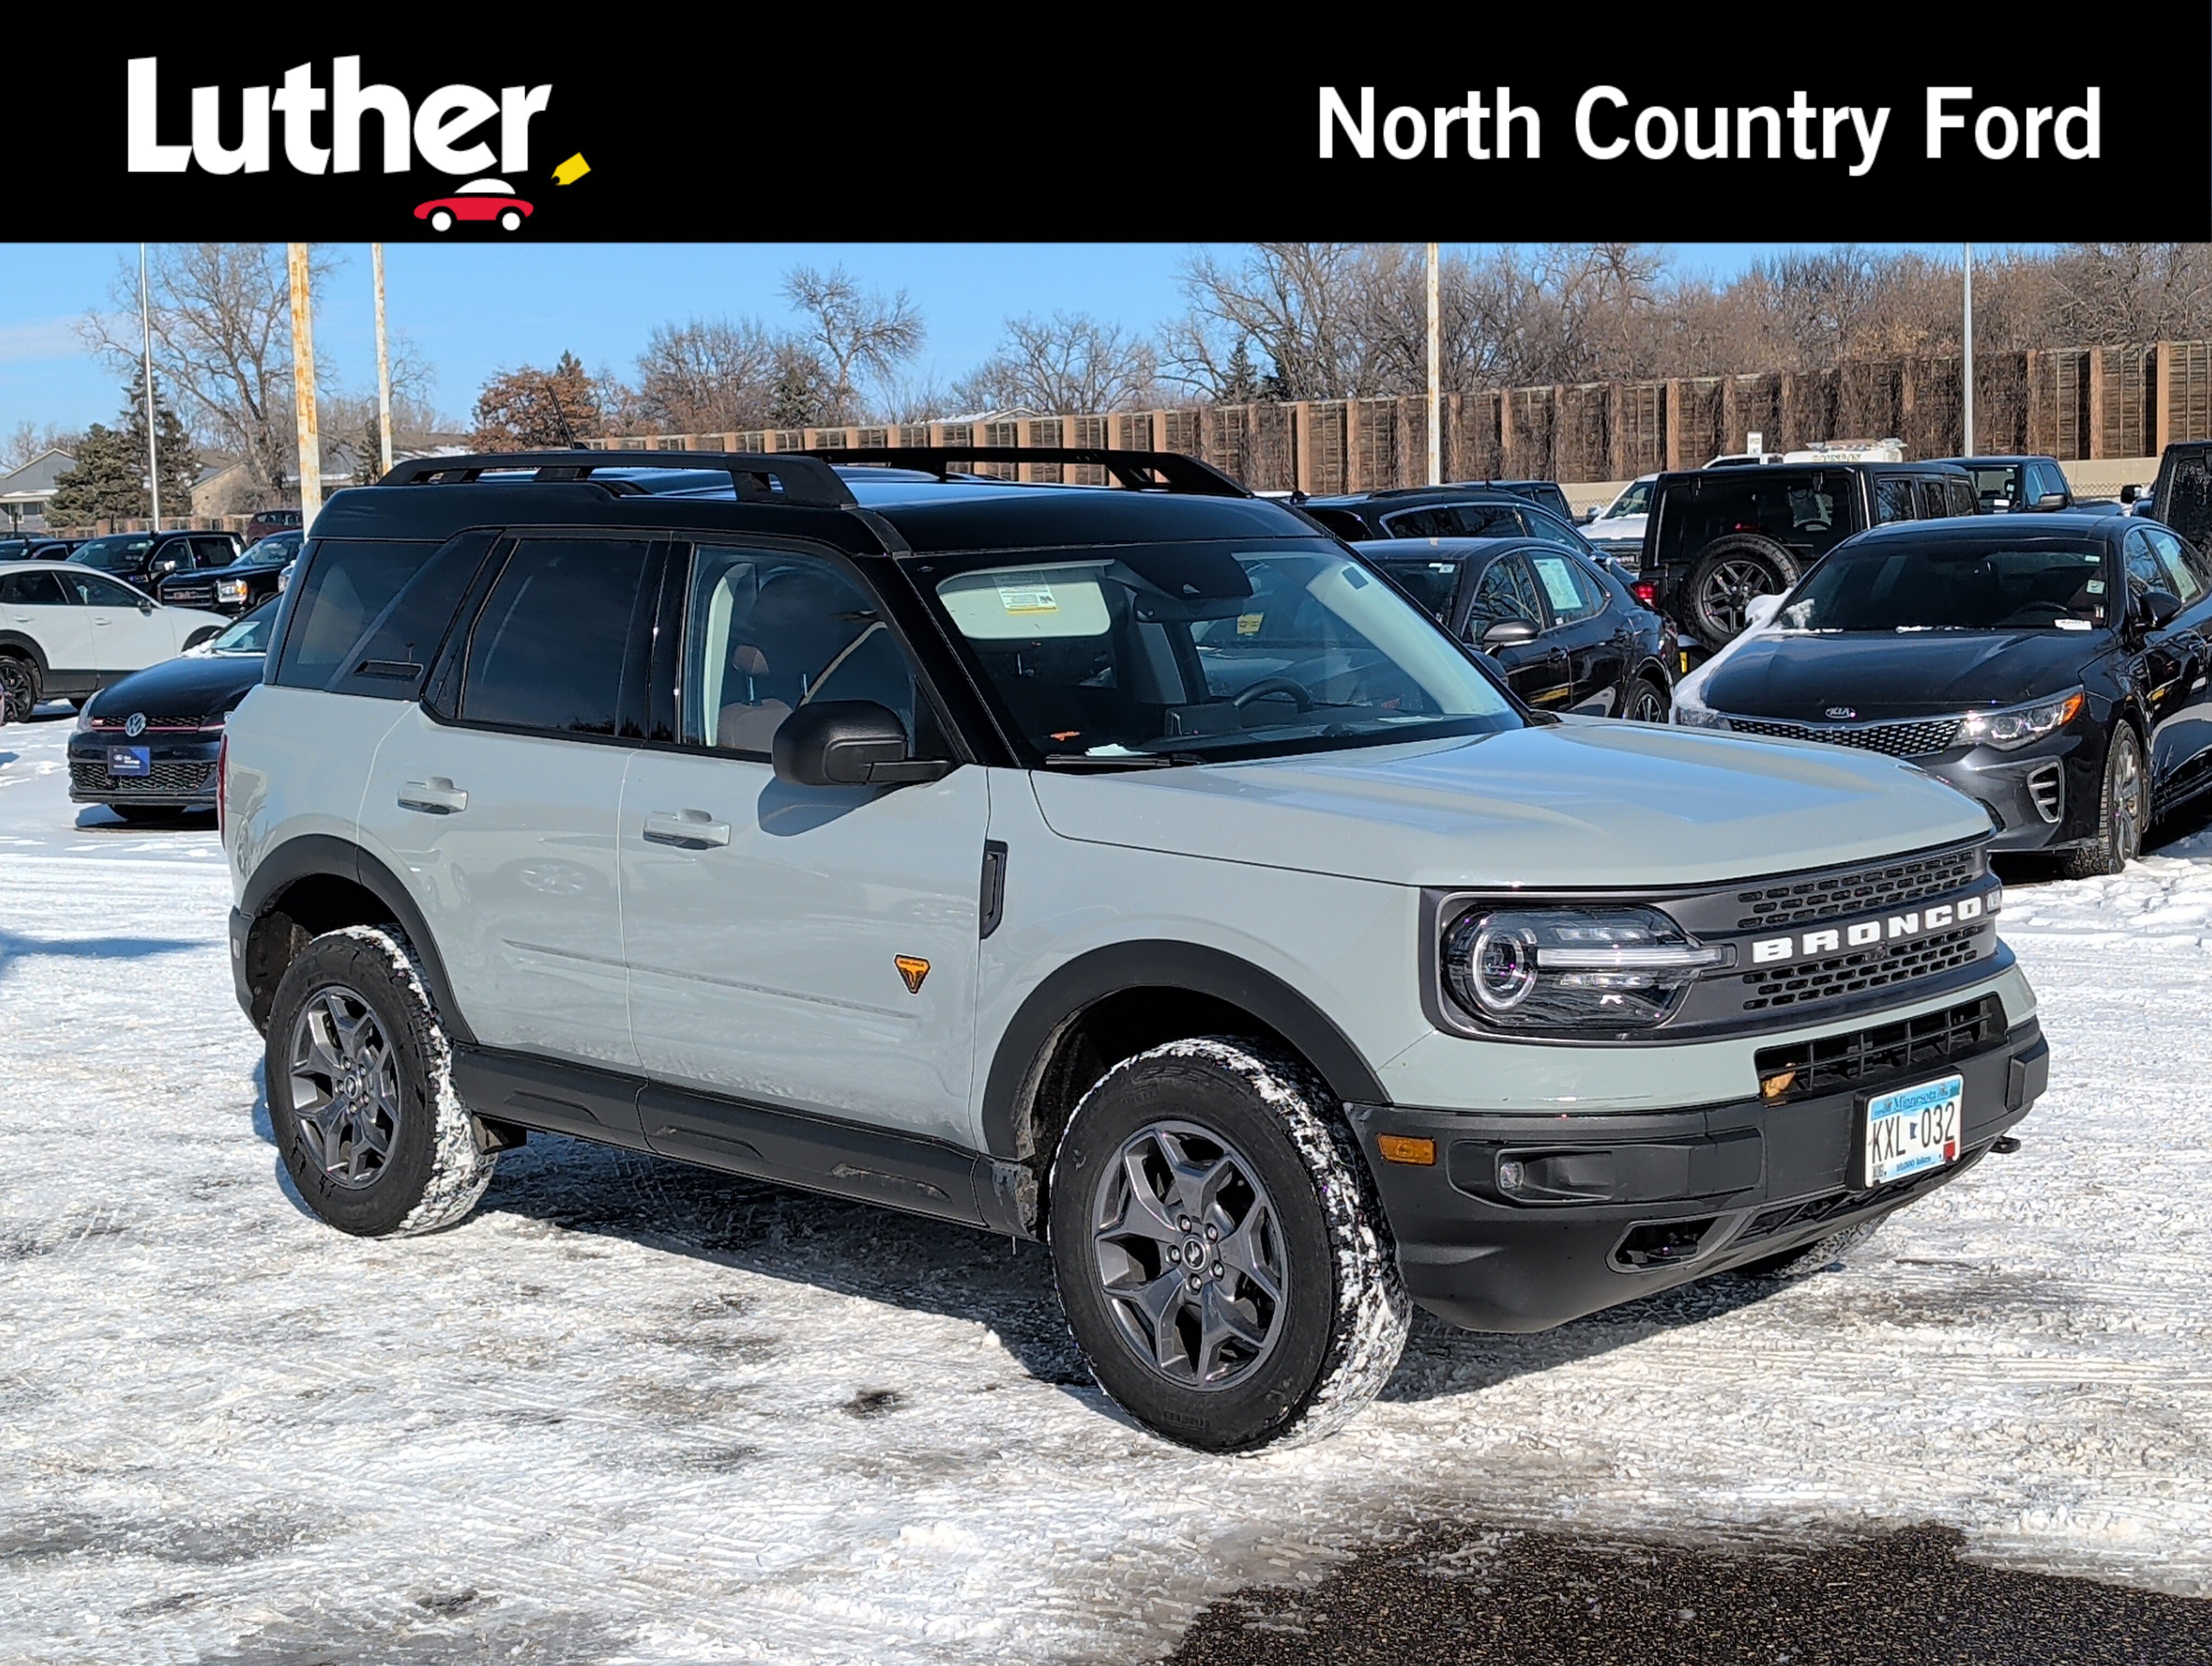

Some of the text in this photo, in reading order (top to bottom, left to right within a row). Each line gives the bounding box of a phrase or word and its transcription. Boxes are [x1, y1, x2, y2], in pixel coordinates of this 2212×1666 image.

[1753, 896, 1982, 964] BRONCO
[1893, 1091, 1935, 1110] Minnesota
[1872, 1101, 1955, 1164] KXL 032
